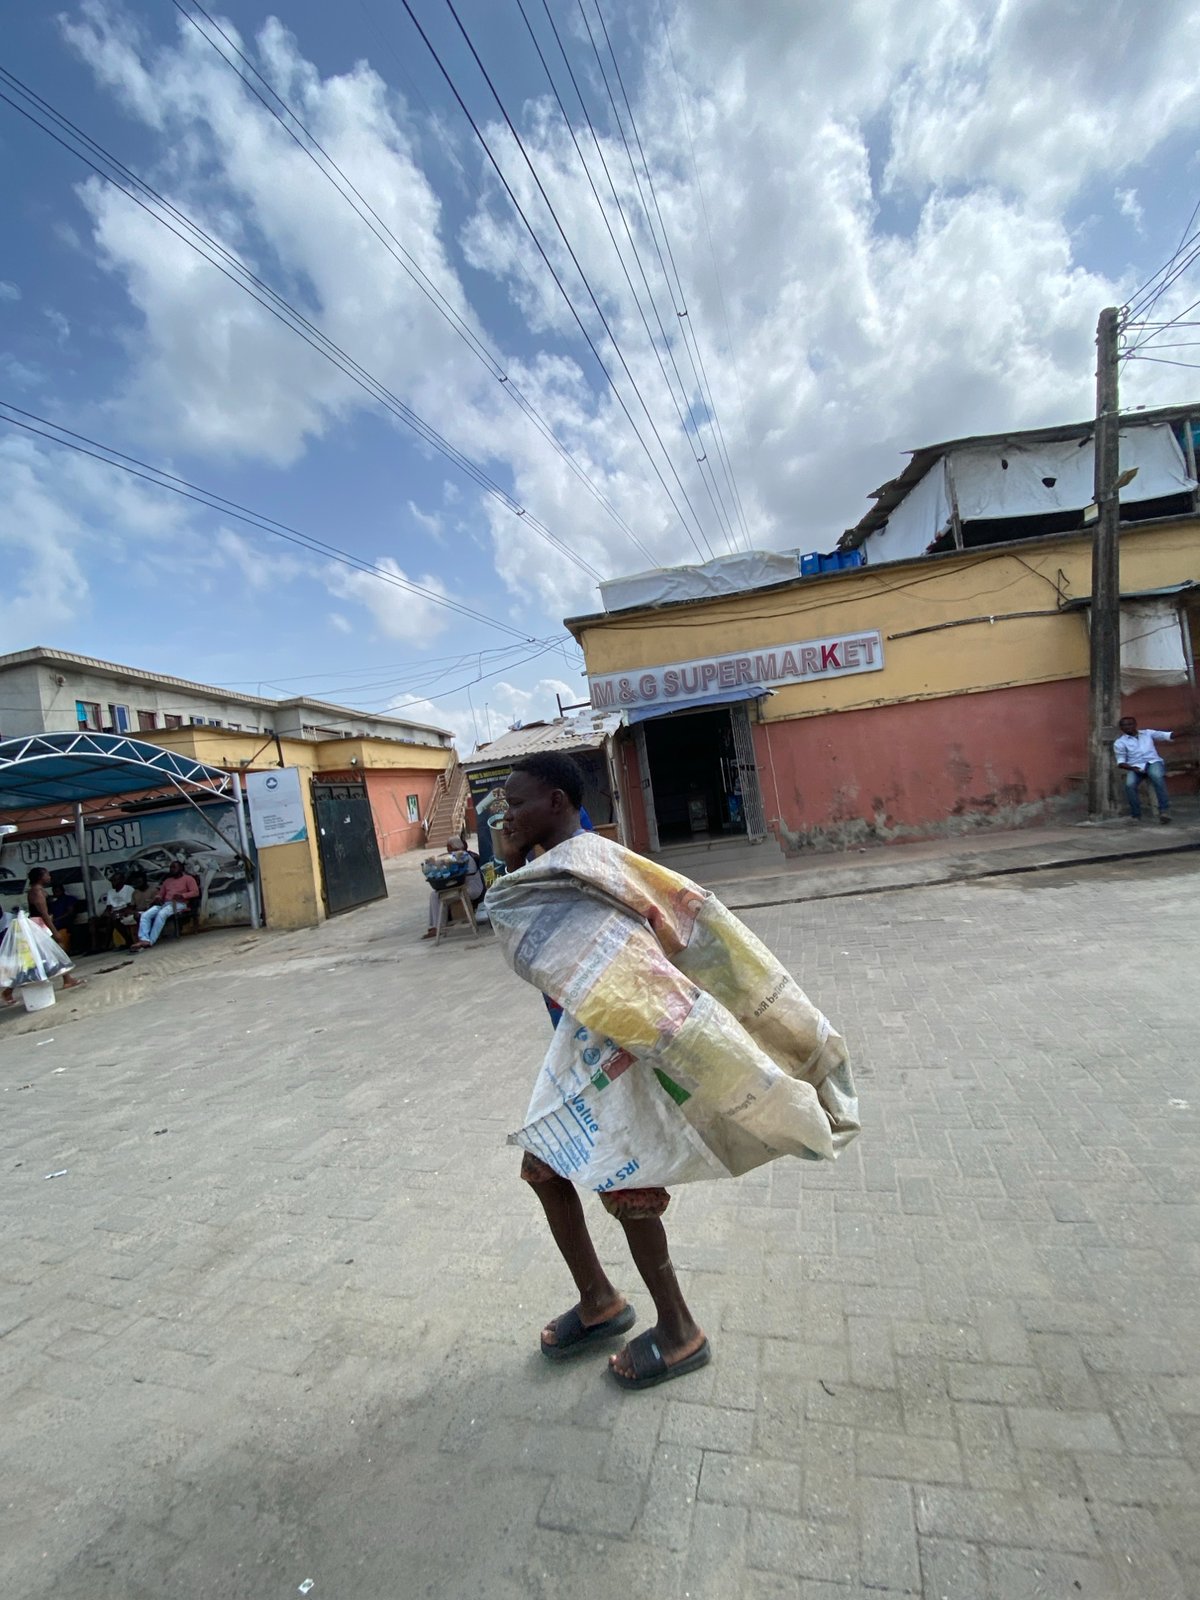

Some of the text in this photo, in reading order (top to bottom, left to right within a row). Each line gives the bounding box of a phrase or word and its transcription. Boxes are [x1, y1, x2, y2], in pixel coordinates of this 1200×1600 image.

[662, 636, 879, 698] SUPERMARKET
[20, 820, 142, 864] CARWASH
[571, 1094, 599, 1133] Value
[615, 1158, 640, 1181] IRS
